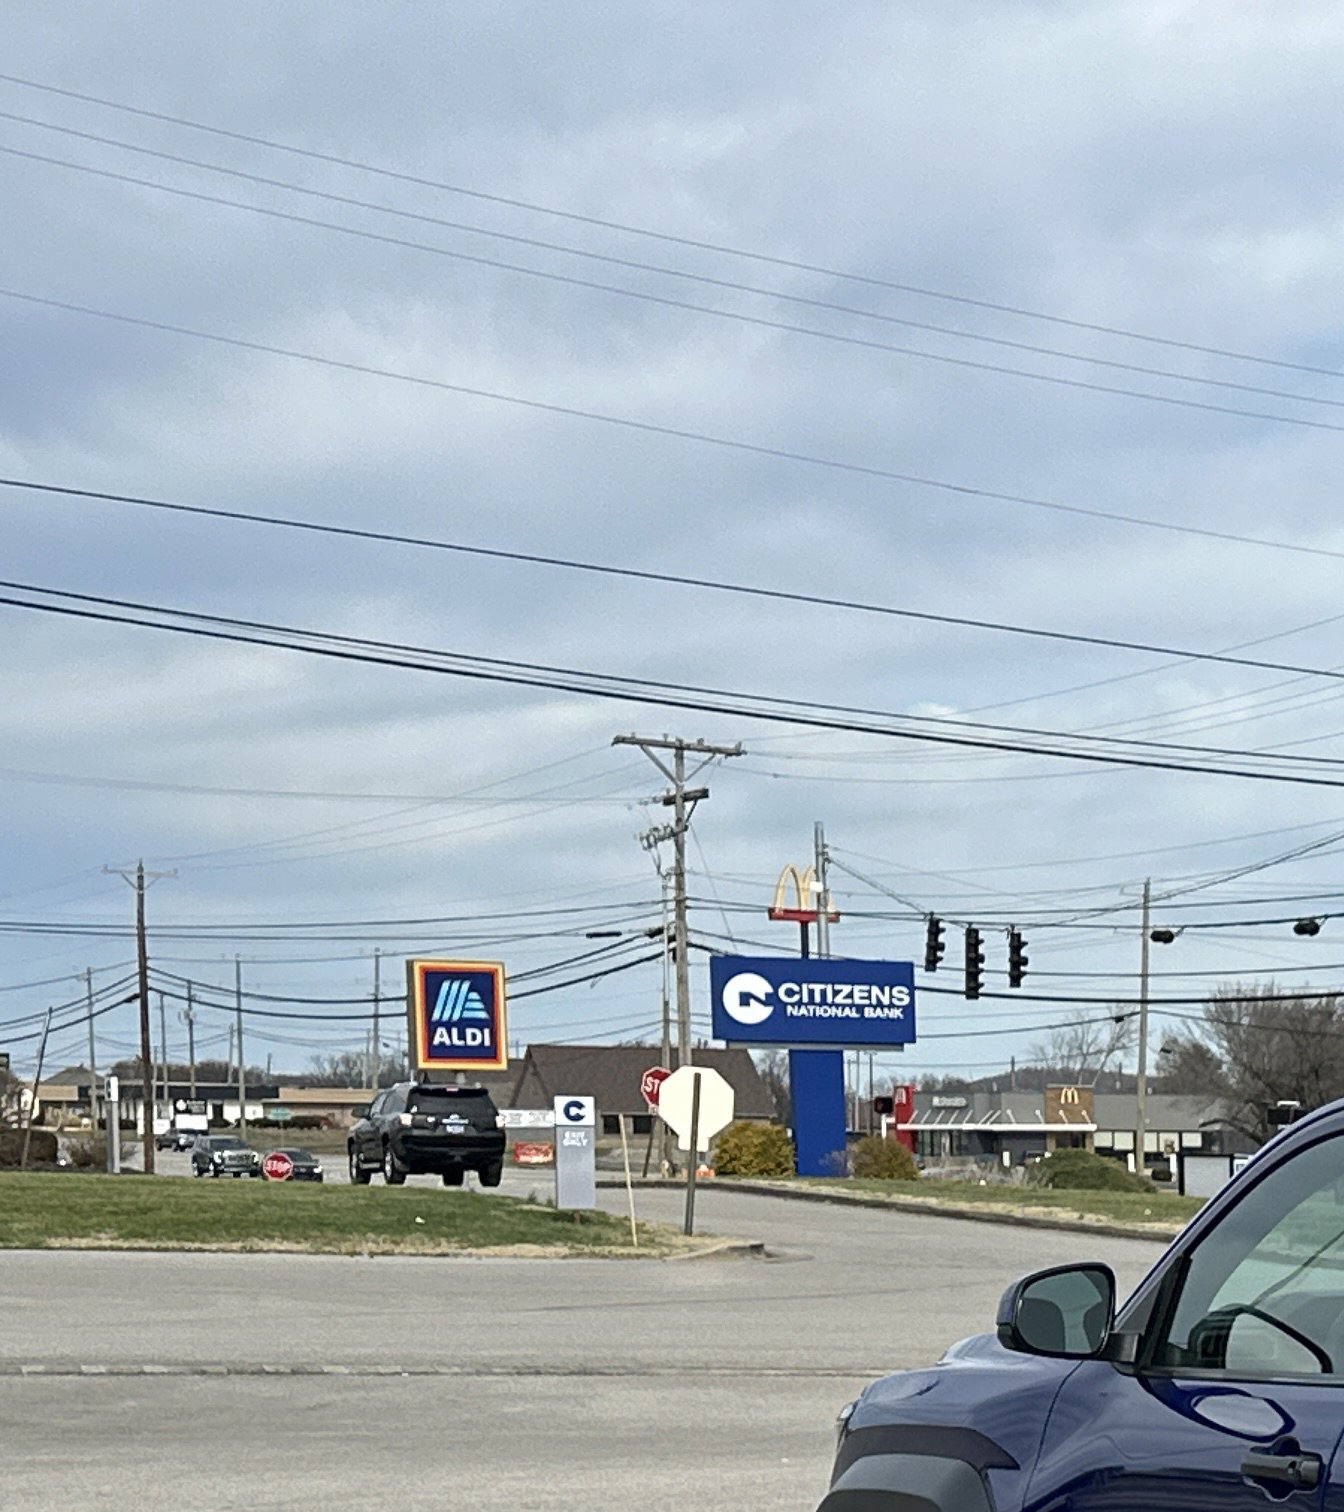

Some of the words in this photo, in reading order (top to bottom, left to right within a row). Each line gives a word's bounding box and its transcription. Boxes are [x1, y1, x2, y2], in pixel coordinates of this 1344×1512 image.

[777, 983, 911, 1006] CITIZENS
[786, 1005, 860, 1018] NATIONAL
[864, 1007, 904, 1020] BANK
[432, 1027, 491, 1046] ALDI
[265, 1160, 291, 1172] STOP
